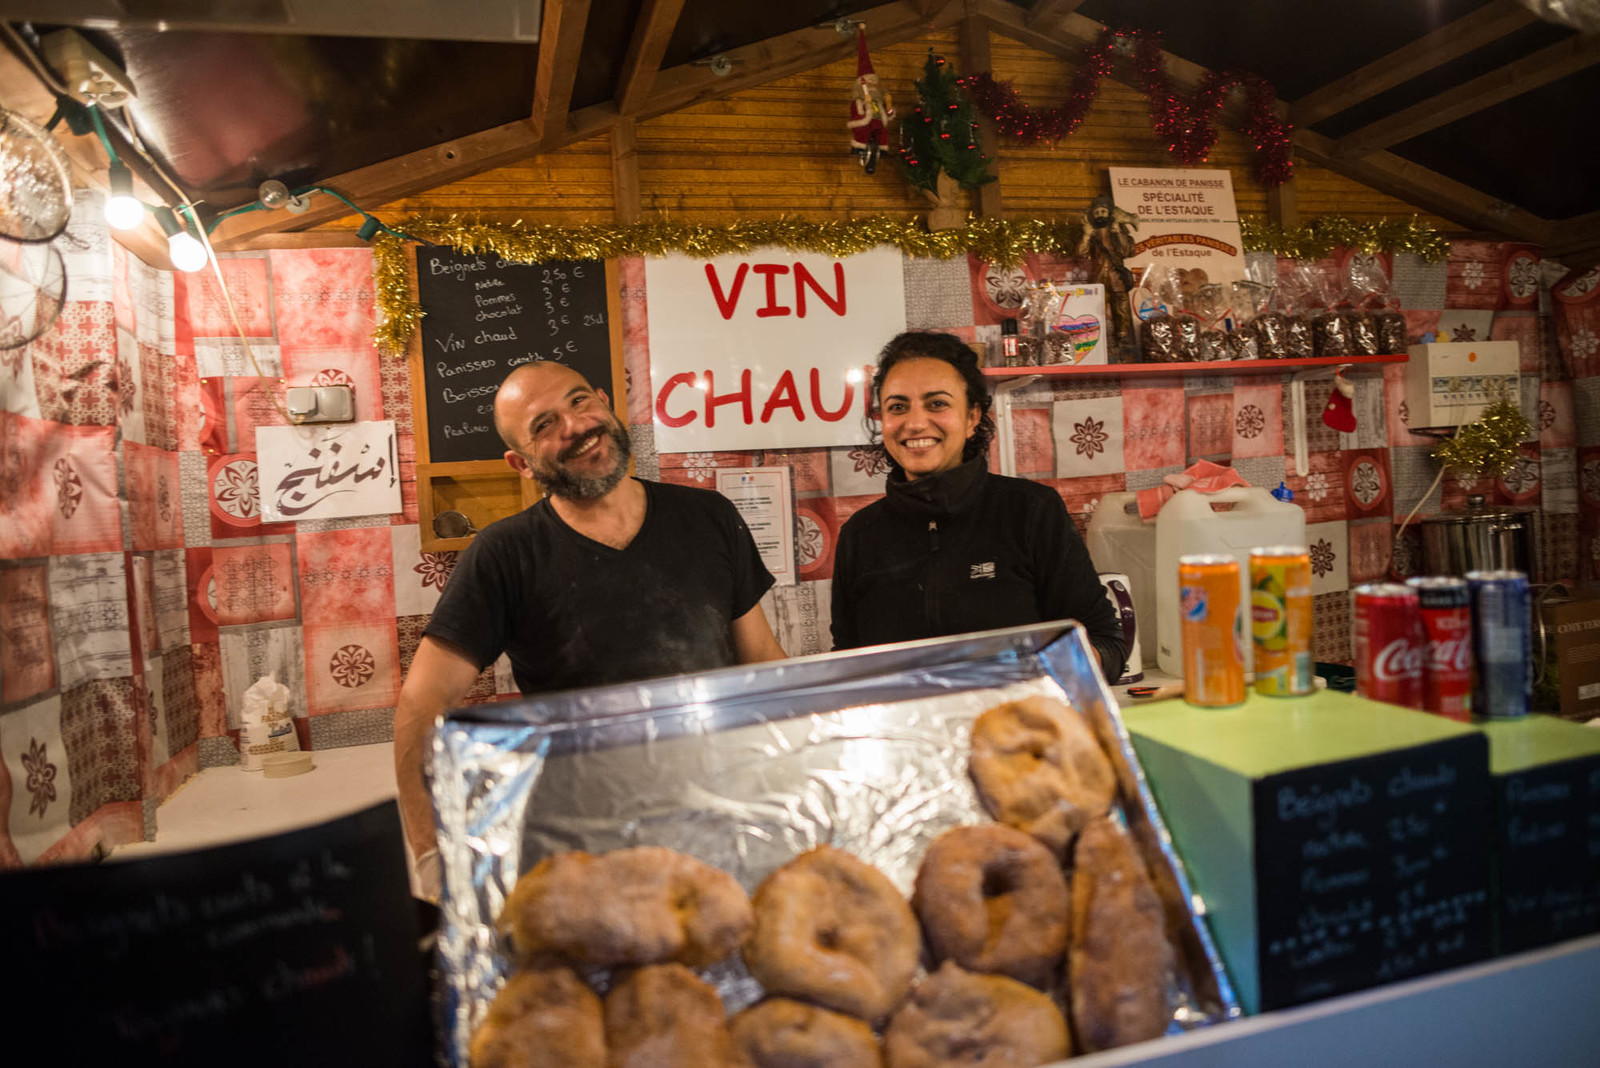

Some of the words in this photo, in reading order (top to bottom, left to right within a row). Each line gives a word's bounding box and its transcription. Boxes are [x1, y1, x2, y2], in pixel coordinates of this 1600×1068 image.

[1117, 178, 1129, 187] LE
[1131, 178, 1174, 187] CABANON
[1175, 179, 1188, 188] DE
[1189, 180, 1225, 188] PANISSE
[1142, 191, 1206, 203] SPÉCIALITÉ
[1137, 205, 1154, 216] DE
[1155, 205, 1216, 216] L'ESTAQUE
[1151, 249, 1164, 257] de
[1166, 248, 1212, 258] l'Estaque
[430, 256, 487, 282] Beignets
[573, 266, 586, 279] €
[475, 293, 517, 308] Pommes
[543, 286, 553, 301] 3
[561, 283, 571, 294] €
[704, 262, 847, 320] VIN
[475, 304, 524, 322] chocolat
[545, 301, 555, 315] 3
[560, 297, 570, 308] €
[475, 326, 519, 346] chaud
[565, 340, 579, 353] €
